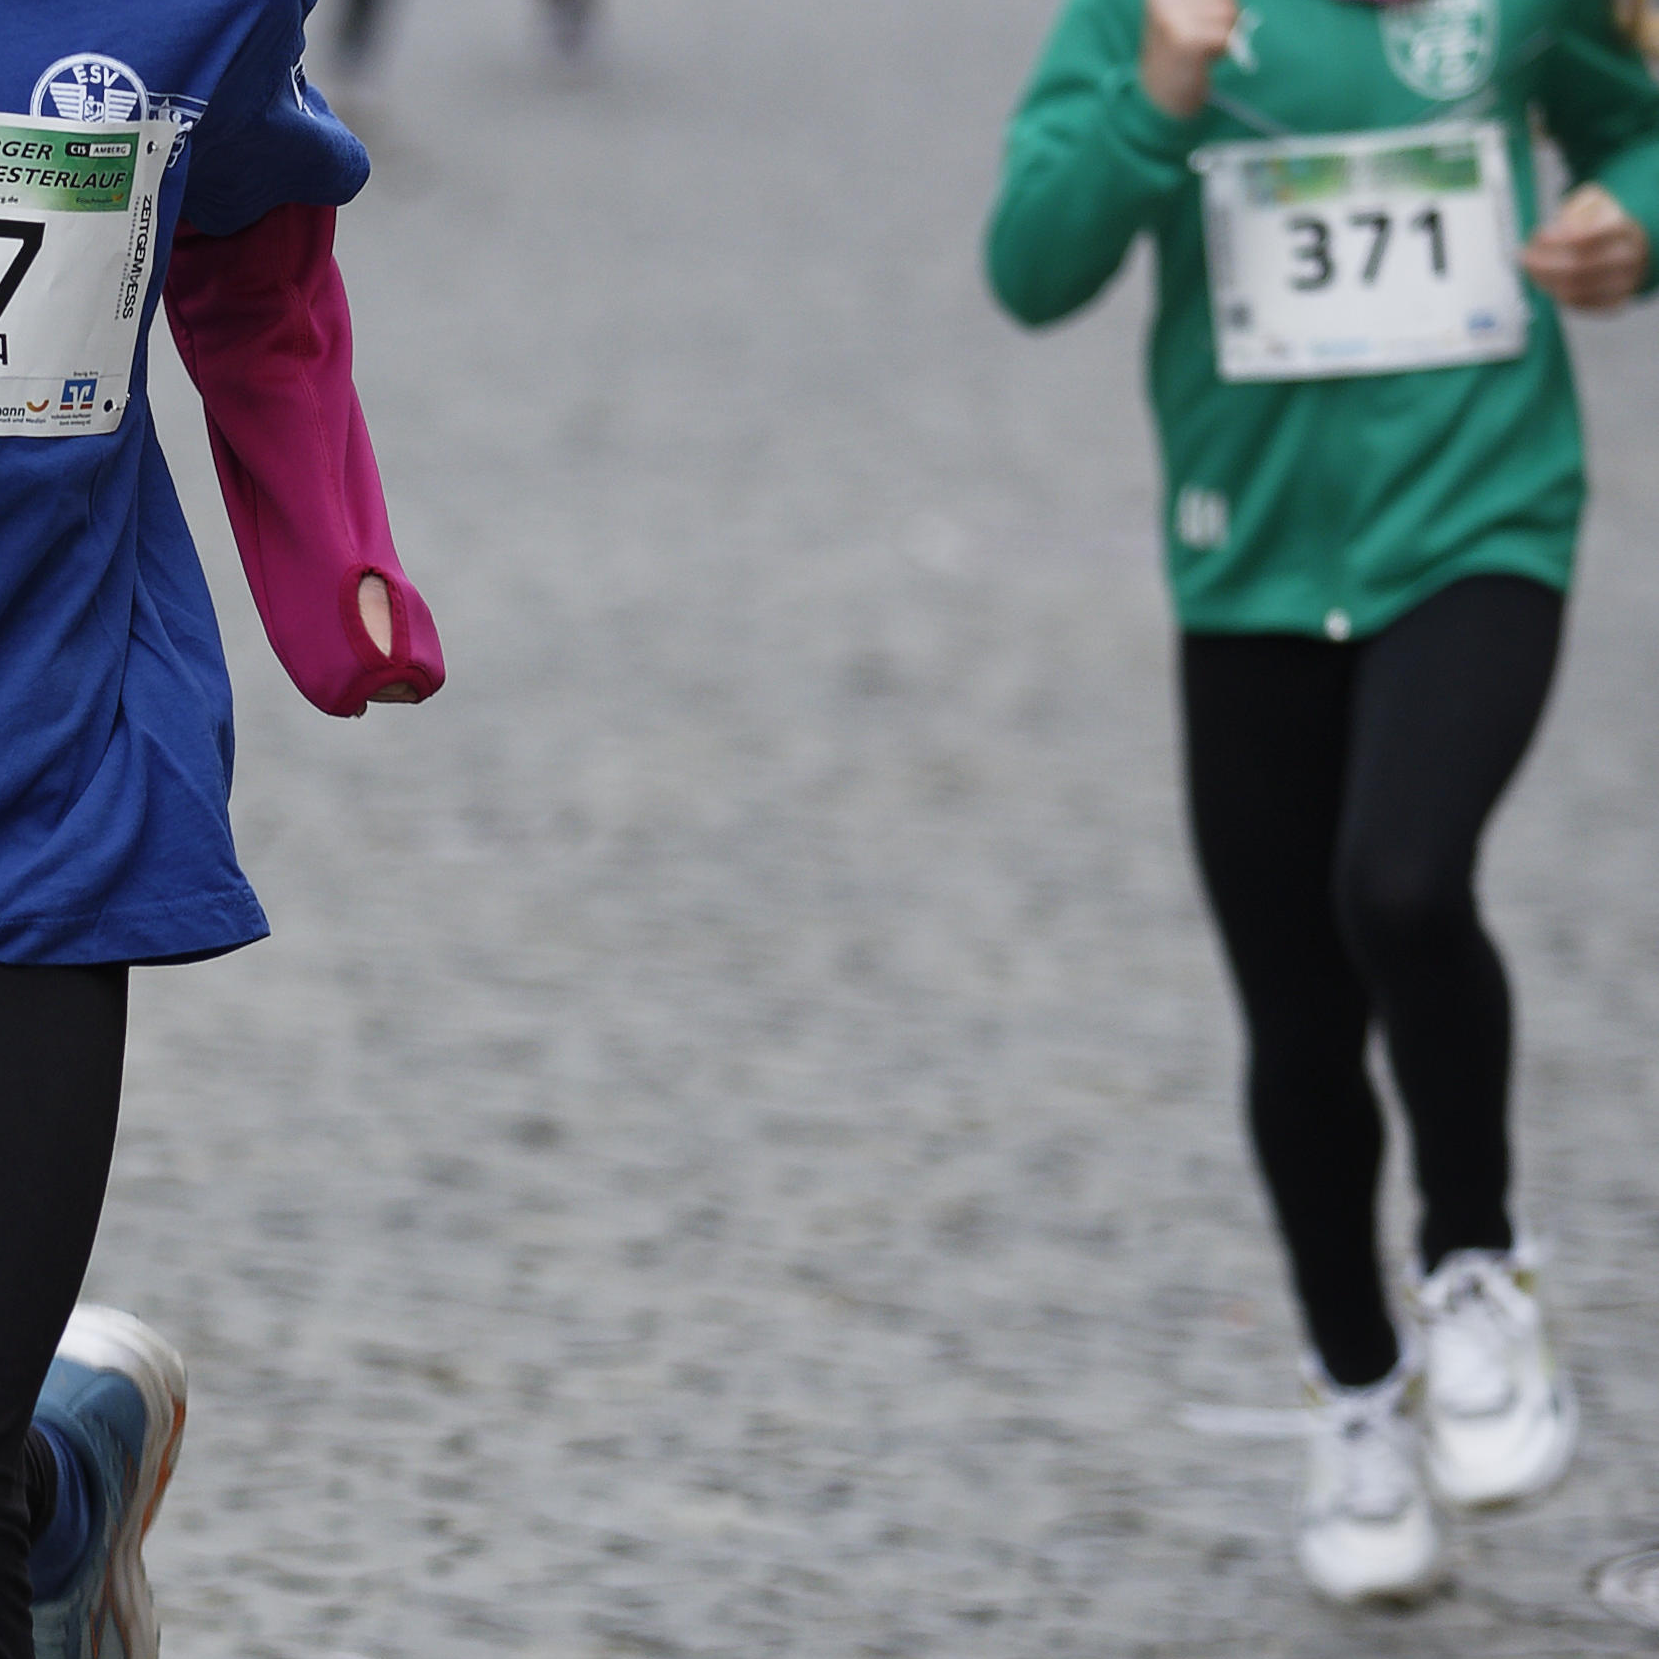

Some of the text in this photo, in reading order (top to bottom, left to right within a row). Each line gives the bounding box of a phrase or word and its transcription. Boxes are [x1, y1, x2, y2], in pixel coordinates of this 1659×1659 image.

[72, 64, 120, 87] ESV
[93, 146, 127, 155] AMBERG
[1286, 208, 1447, 292] 371
